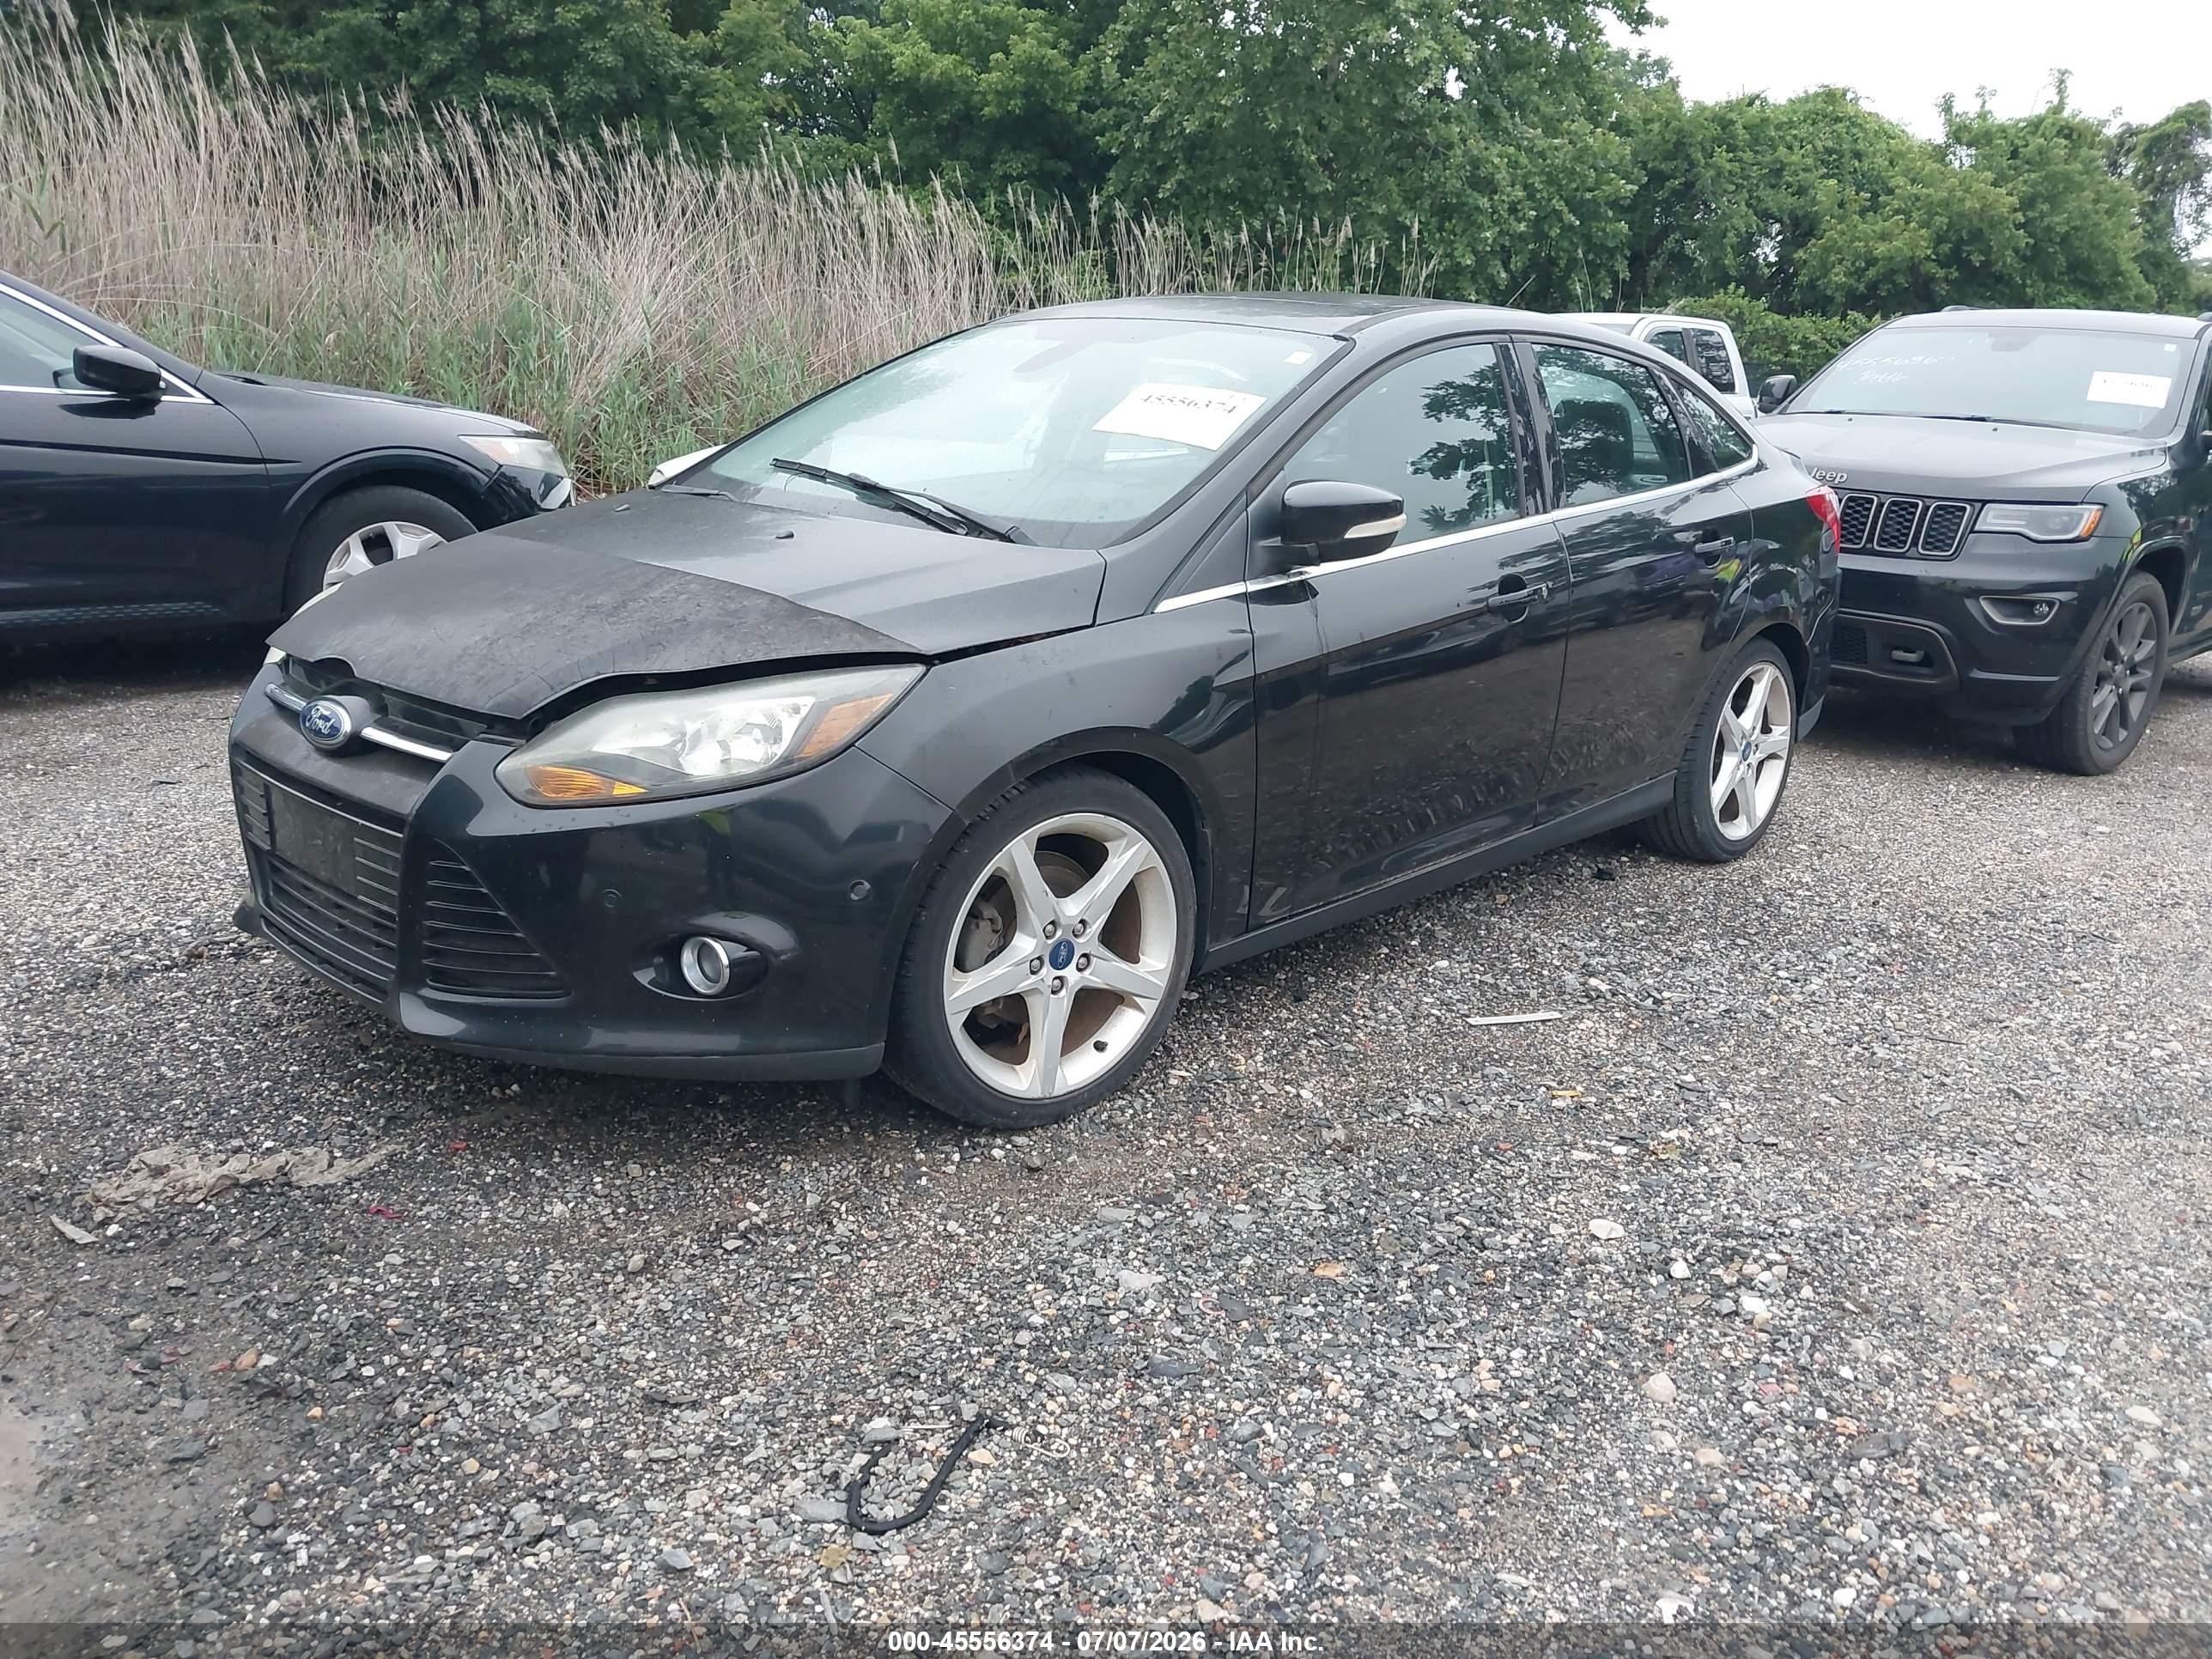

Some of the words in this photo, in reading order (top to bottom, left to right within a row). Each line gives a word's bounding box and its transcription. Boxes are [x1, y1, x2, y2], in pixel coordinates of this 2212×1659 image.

[1139, 392, 1238, 415] 45556374
[1810, 466, 1848, 484] Jeep
[305, 705, 334, 735] Ford
